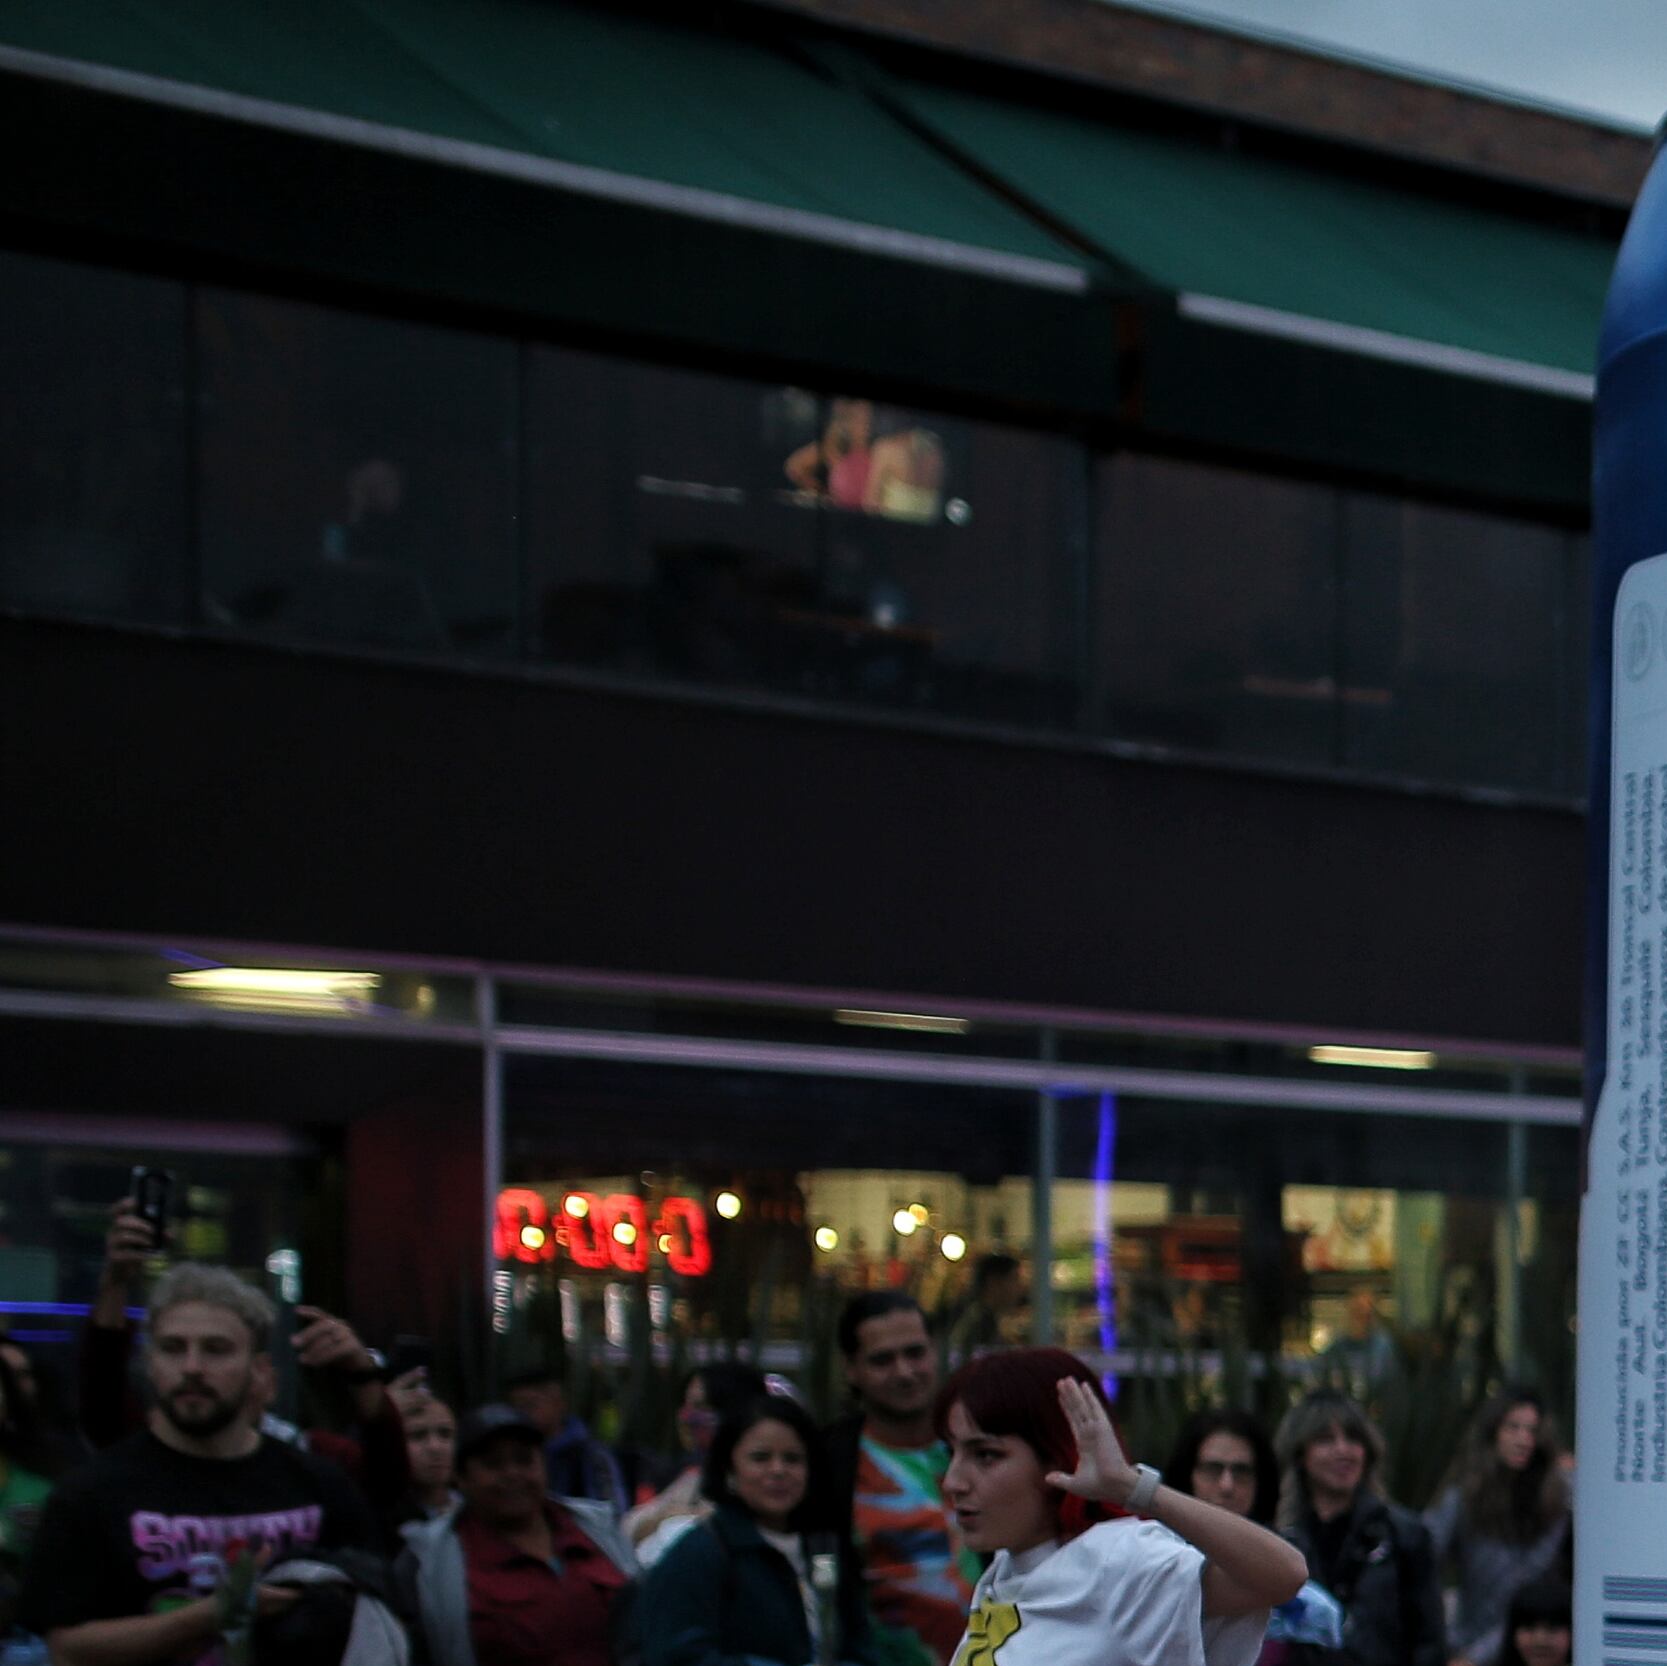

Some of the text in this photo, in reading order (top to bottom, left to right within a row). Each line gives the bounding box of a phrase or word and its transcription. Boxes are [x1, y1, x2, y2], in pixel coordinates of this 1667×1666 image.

[1621, 770, 1638, 876] Central
[1638, 768, 1655, 915] Colombia.
[1621, 883, 1636, 986] Troncal
[1632, 1399, 1646, 1483] Norte
